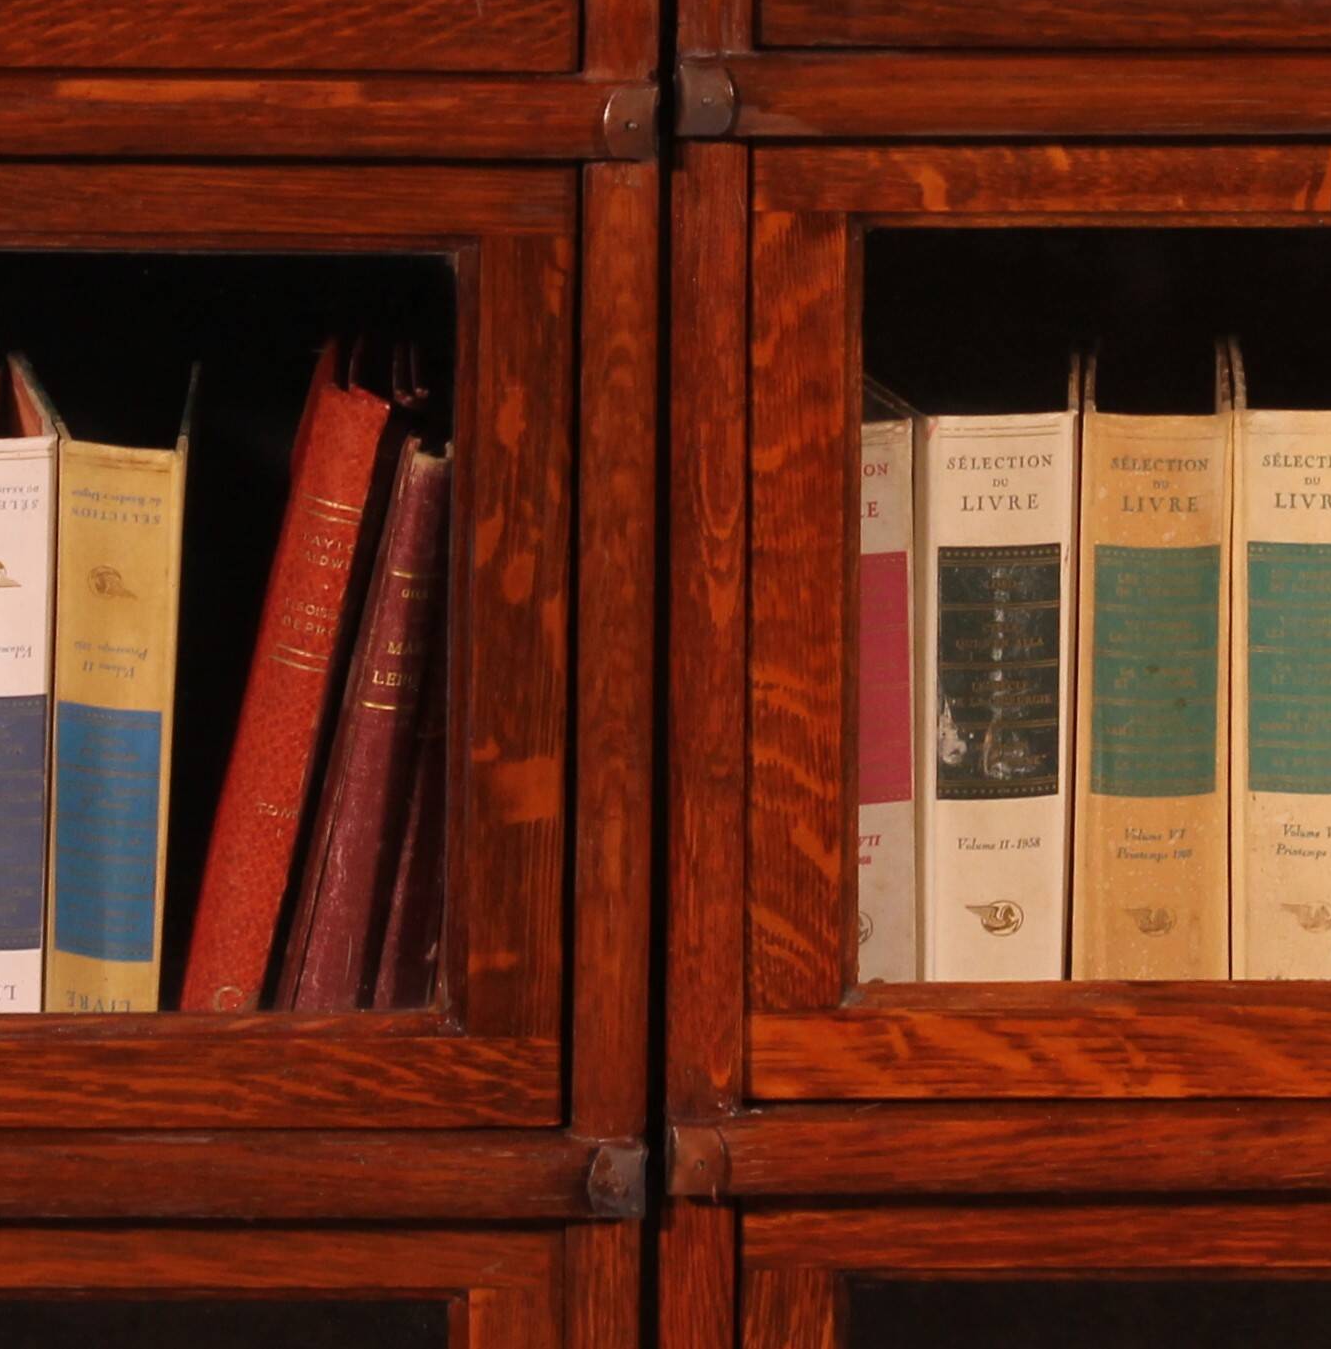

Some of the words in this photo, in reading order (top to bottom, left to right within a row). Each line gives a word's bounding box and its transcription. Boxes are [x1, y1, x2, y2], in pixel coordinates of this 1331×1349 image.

[946, 453, 1053, 472] SÉLECTION
[992, 479, 1010, 489] DU
[1304, 477, 1322, 487] DU
[960, 493, 1040, 513] LIVRE
[1121, 495, 1200, 514] LIVRE
[1282, 823, 1321, 839] Volume
[956, 836, 998, 852] Volume
[1275, 842, 1328, 860] Printemps
